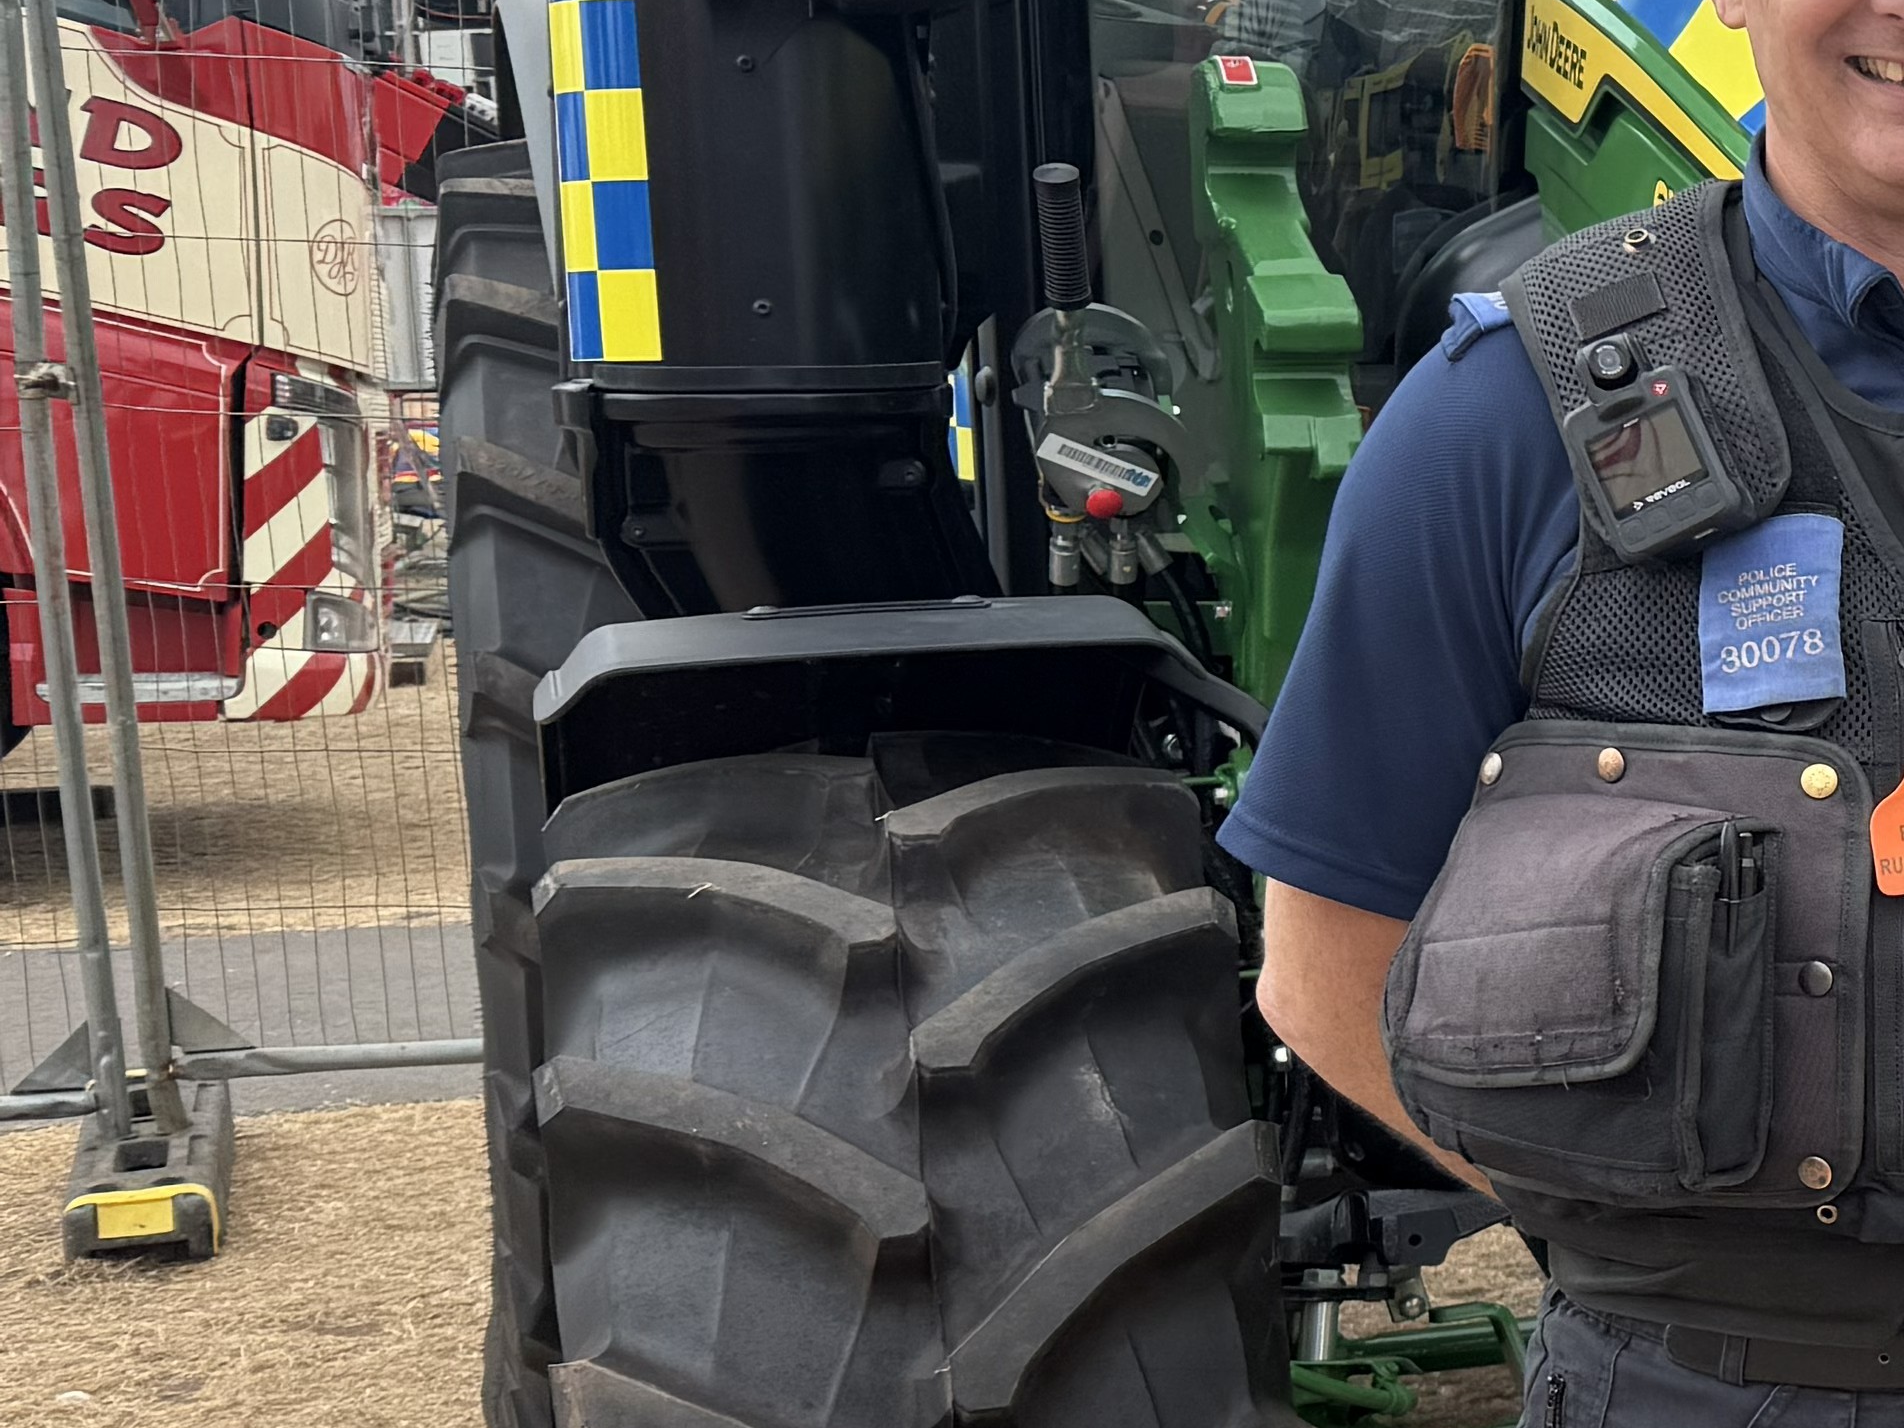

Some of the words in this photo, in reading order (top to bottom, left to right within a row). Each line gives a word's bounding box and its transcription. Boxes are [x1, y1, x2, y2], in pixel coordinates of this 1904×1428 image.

[1549, 21, 1588, 90] DEERE
[1738, 562, 1797, 585] POLICE
[1717, 575, 1819, 603] COMMUNITY
[1731, 590, 1808, 617] SUPPORT
[1735, 605, 1805, 630] OFFICER
[1720, 628, 1825, 673] 30078
